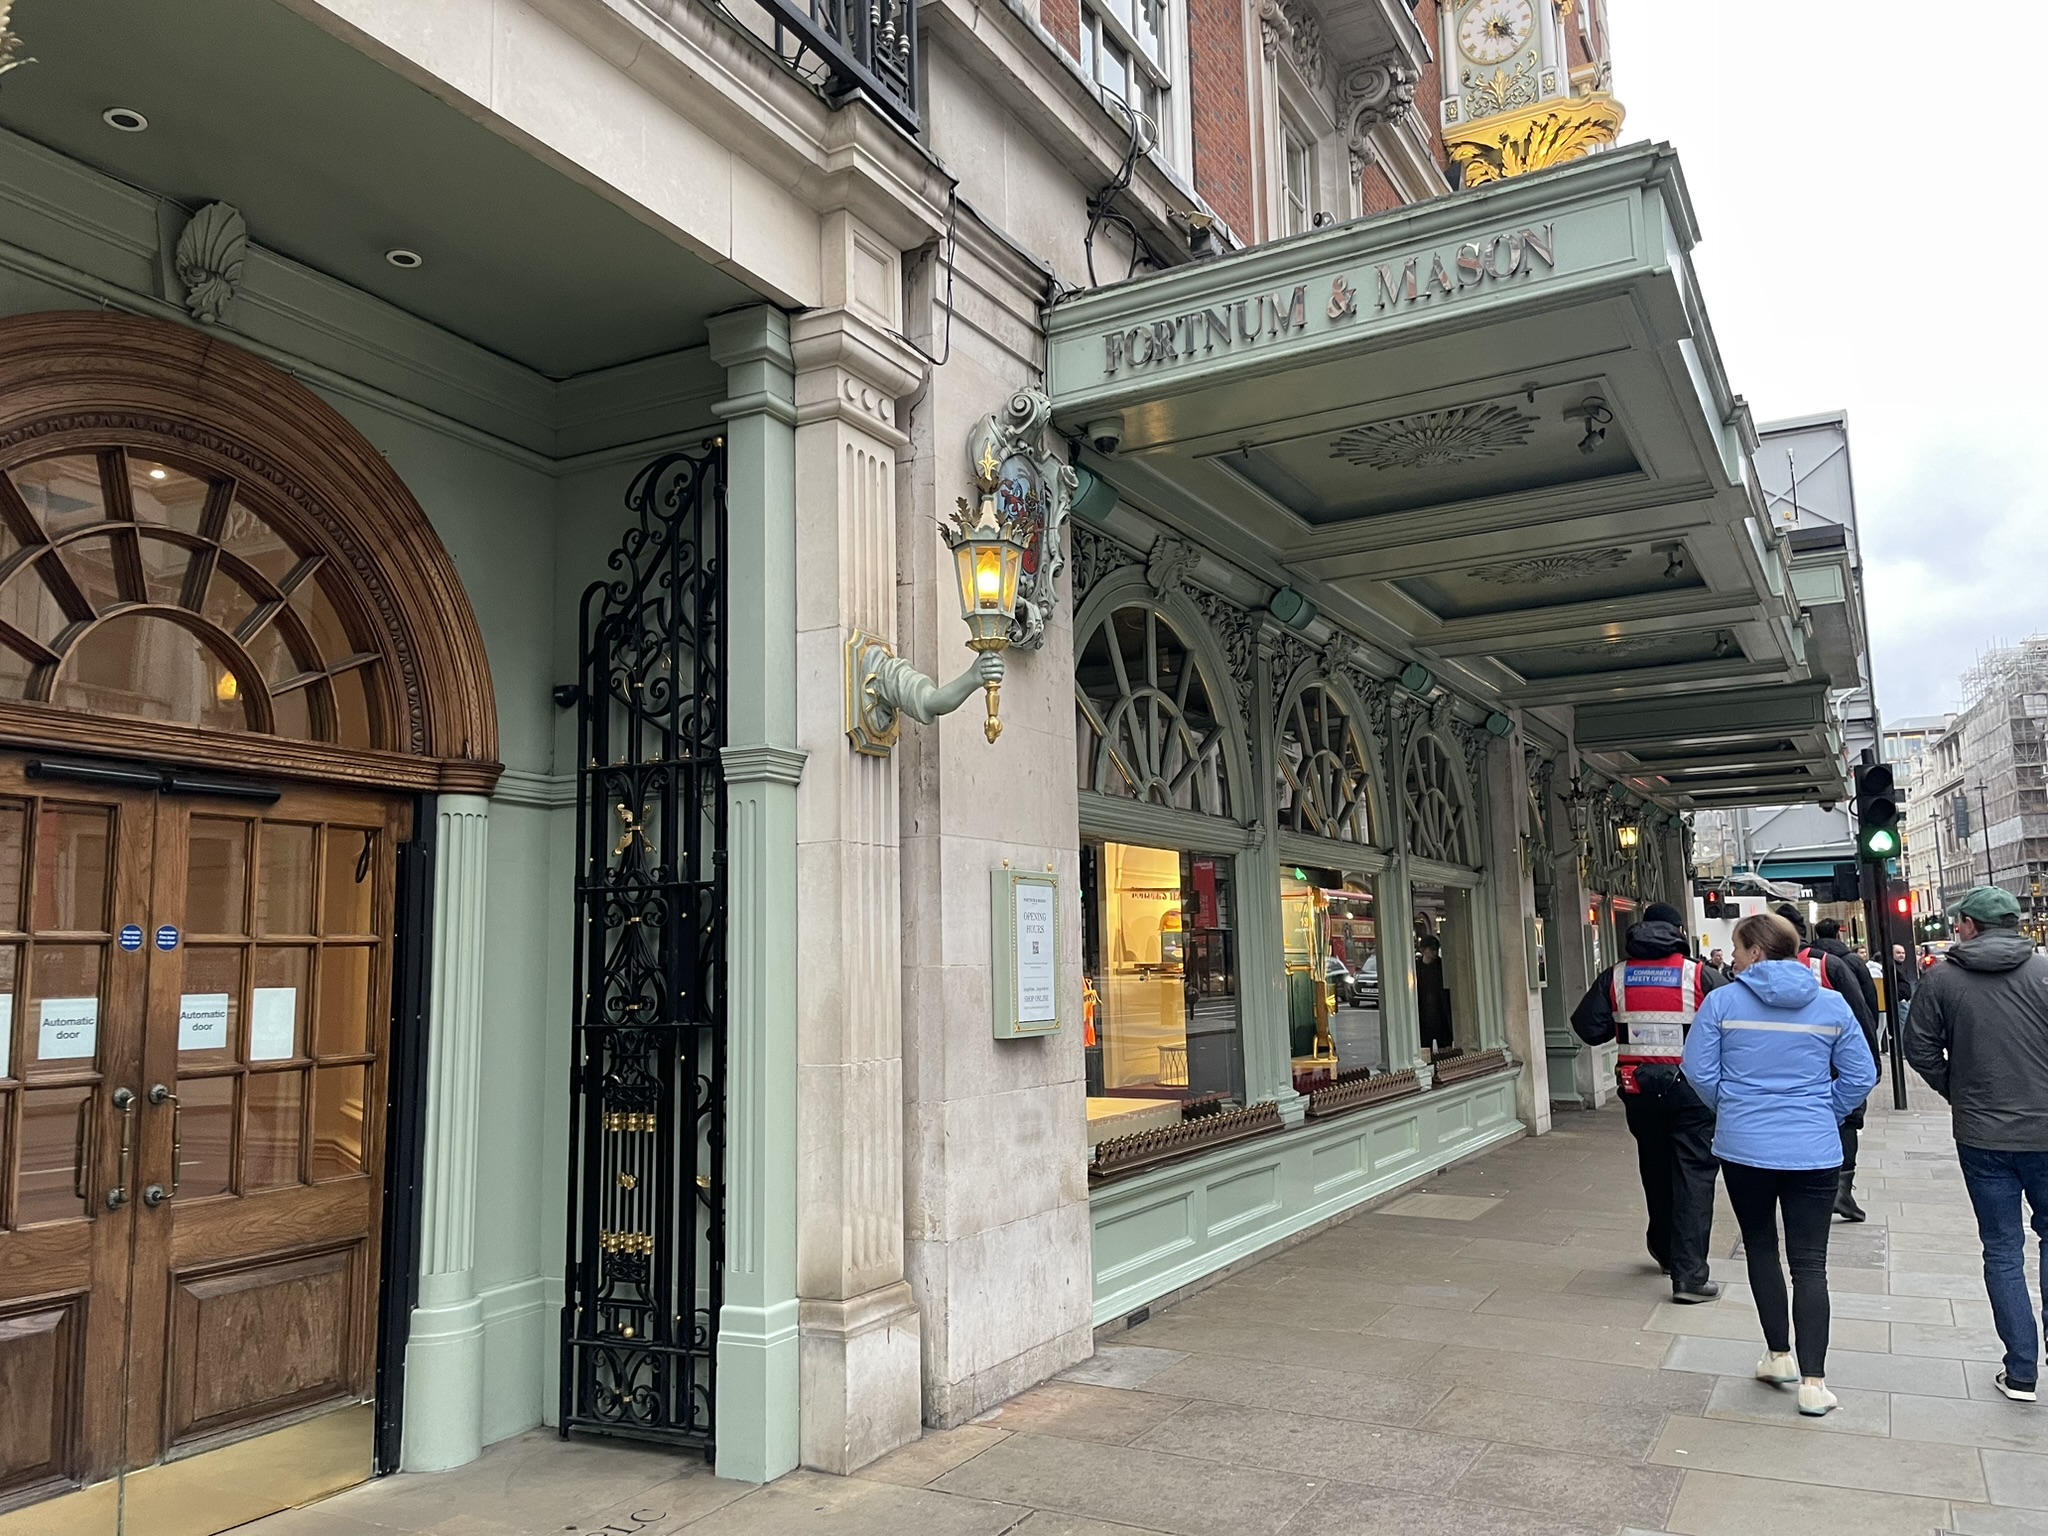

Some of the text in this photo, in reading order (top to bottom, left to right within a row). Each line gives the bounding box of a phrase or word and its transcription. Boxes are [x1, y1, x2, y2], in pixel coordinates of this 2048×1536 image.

[1102, 223, 1555, 374] FORTNUM & MASON
[1024, 912, 1046, 922] OPENING
[180, 1010, 226, 1020] Automatic
[42, 1017, 95, 1027] Automatic
[192, 1022, 214, 1032] door
[56, 1030, 80, 1039] door
